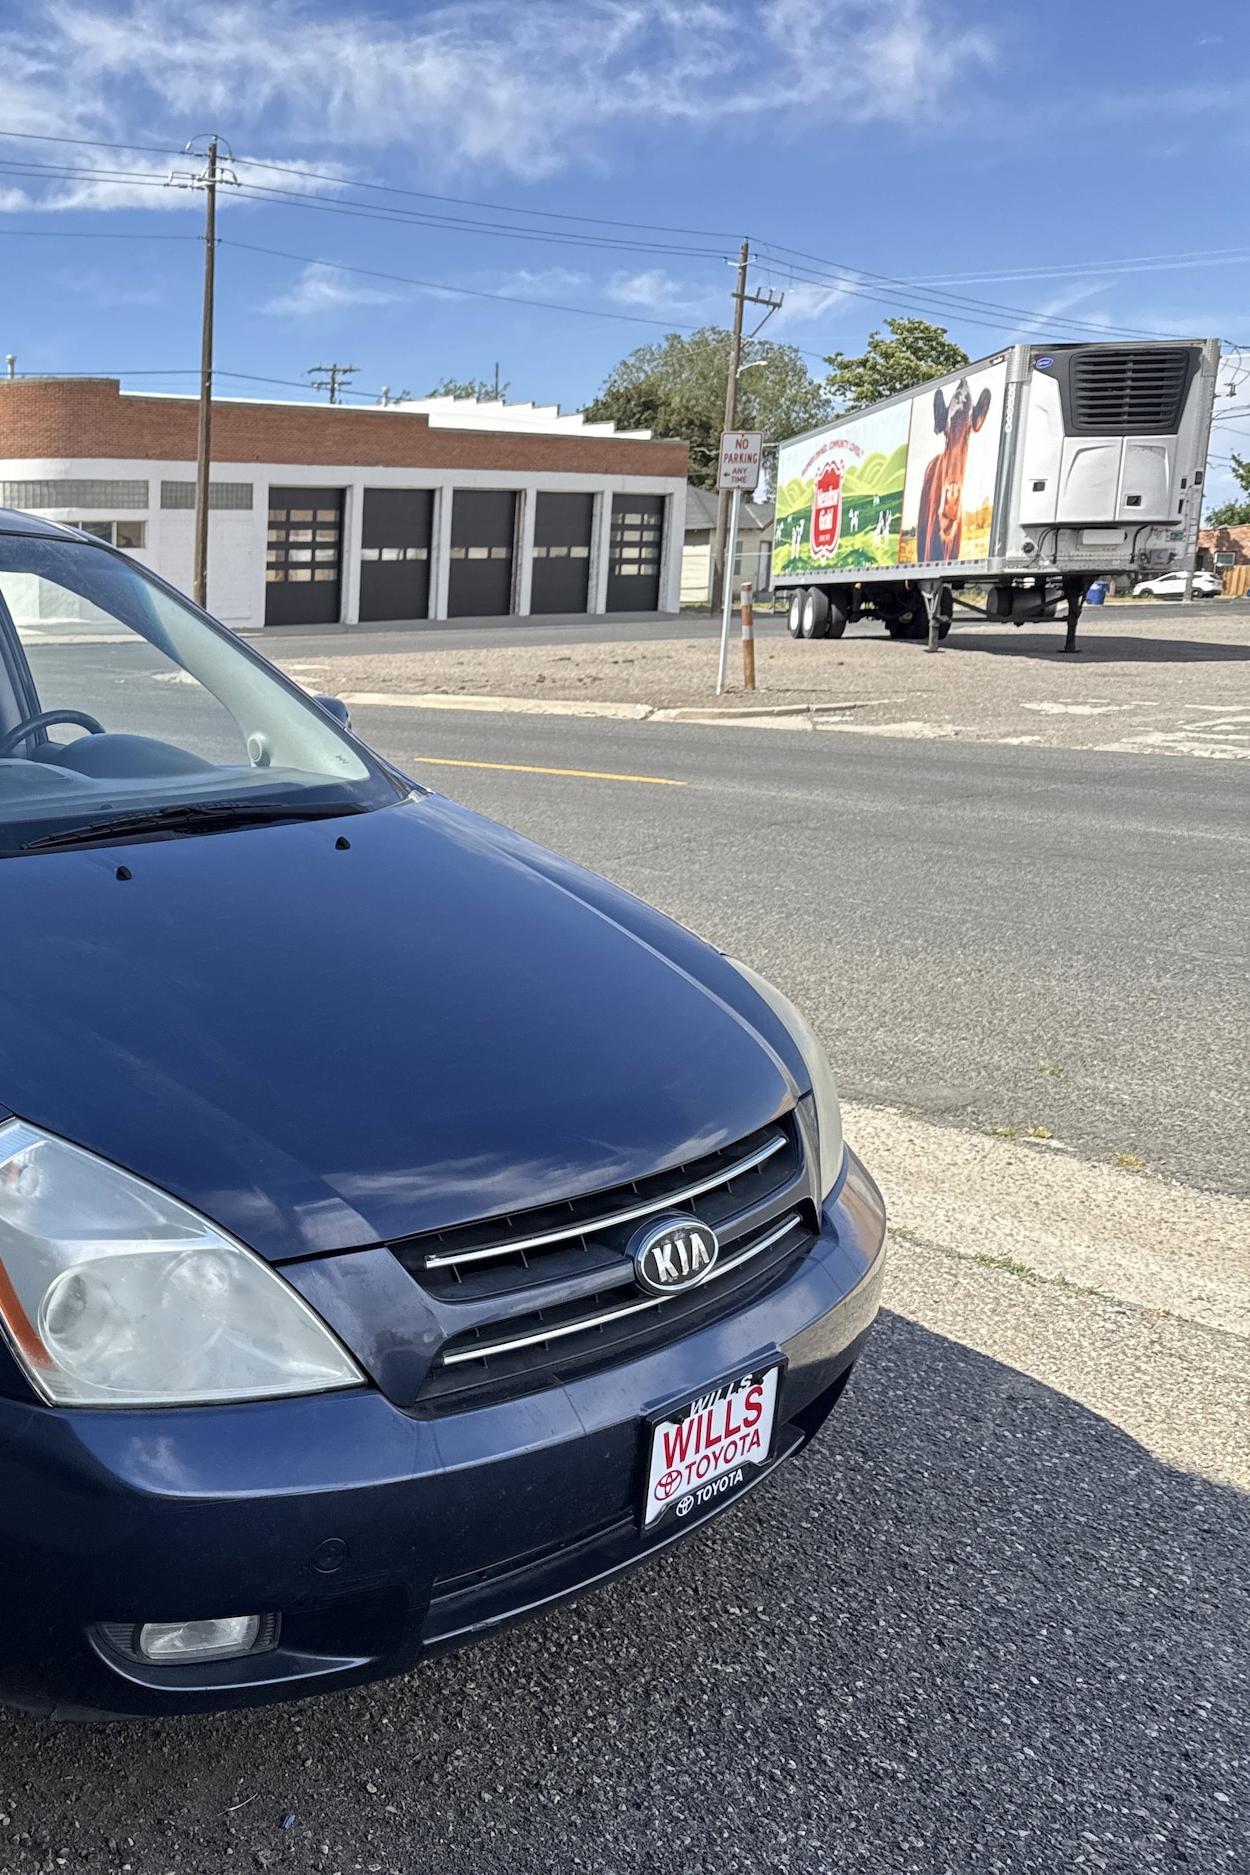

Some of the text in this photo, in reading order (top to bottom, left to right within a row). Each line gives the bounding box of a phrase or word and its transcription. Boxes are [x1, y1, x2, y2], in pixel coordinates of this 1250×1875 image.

[723, 452, 758, 464] PARKING
[735, 438, 749, 450] NO
[731, 475, 747, 483] TIME
[732, 467, 748, 475] ANY
[651, 1232, 711, 1283] KIA
[689, 1373, 753, 1417] WILLS
[663, 1384, 764, 1470] WILLS
[684, 1428, 762, 1486] TOYOTA
[695, 1468, 744, 1506] TOYOTA
